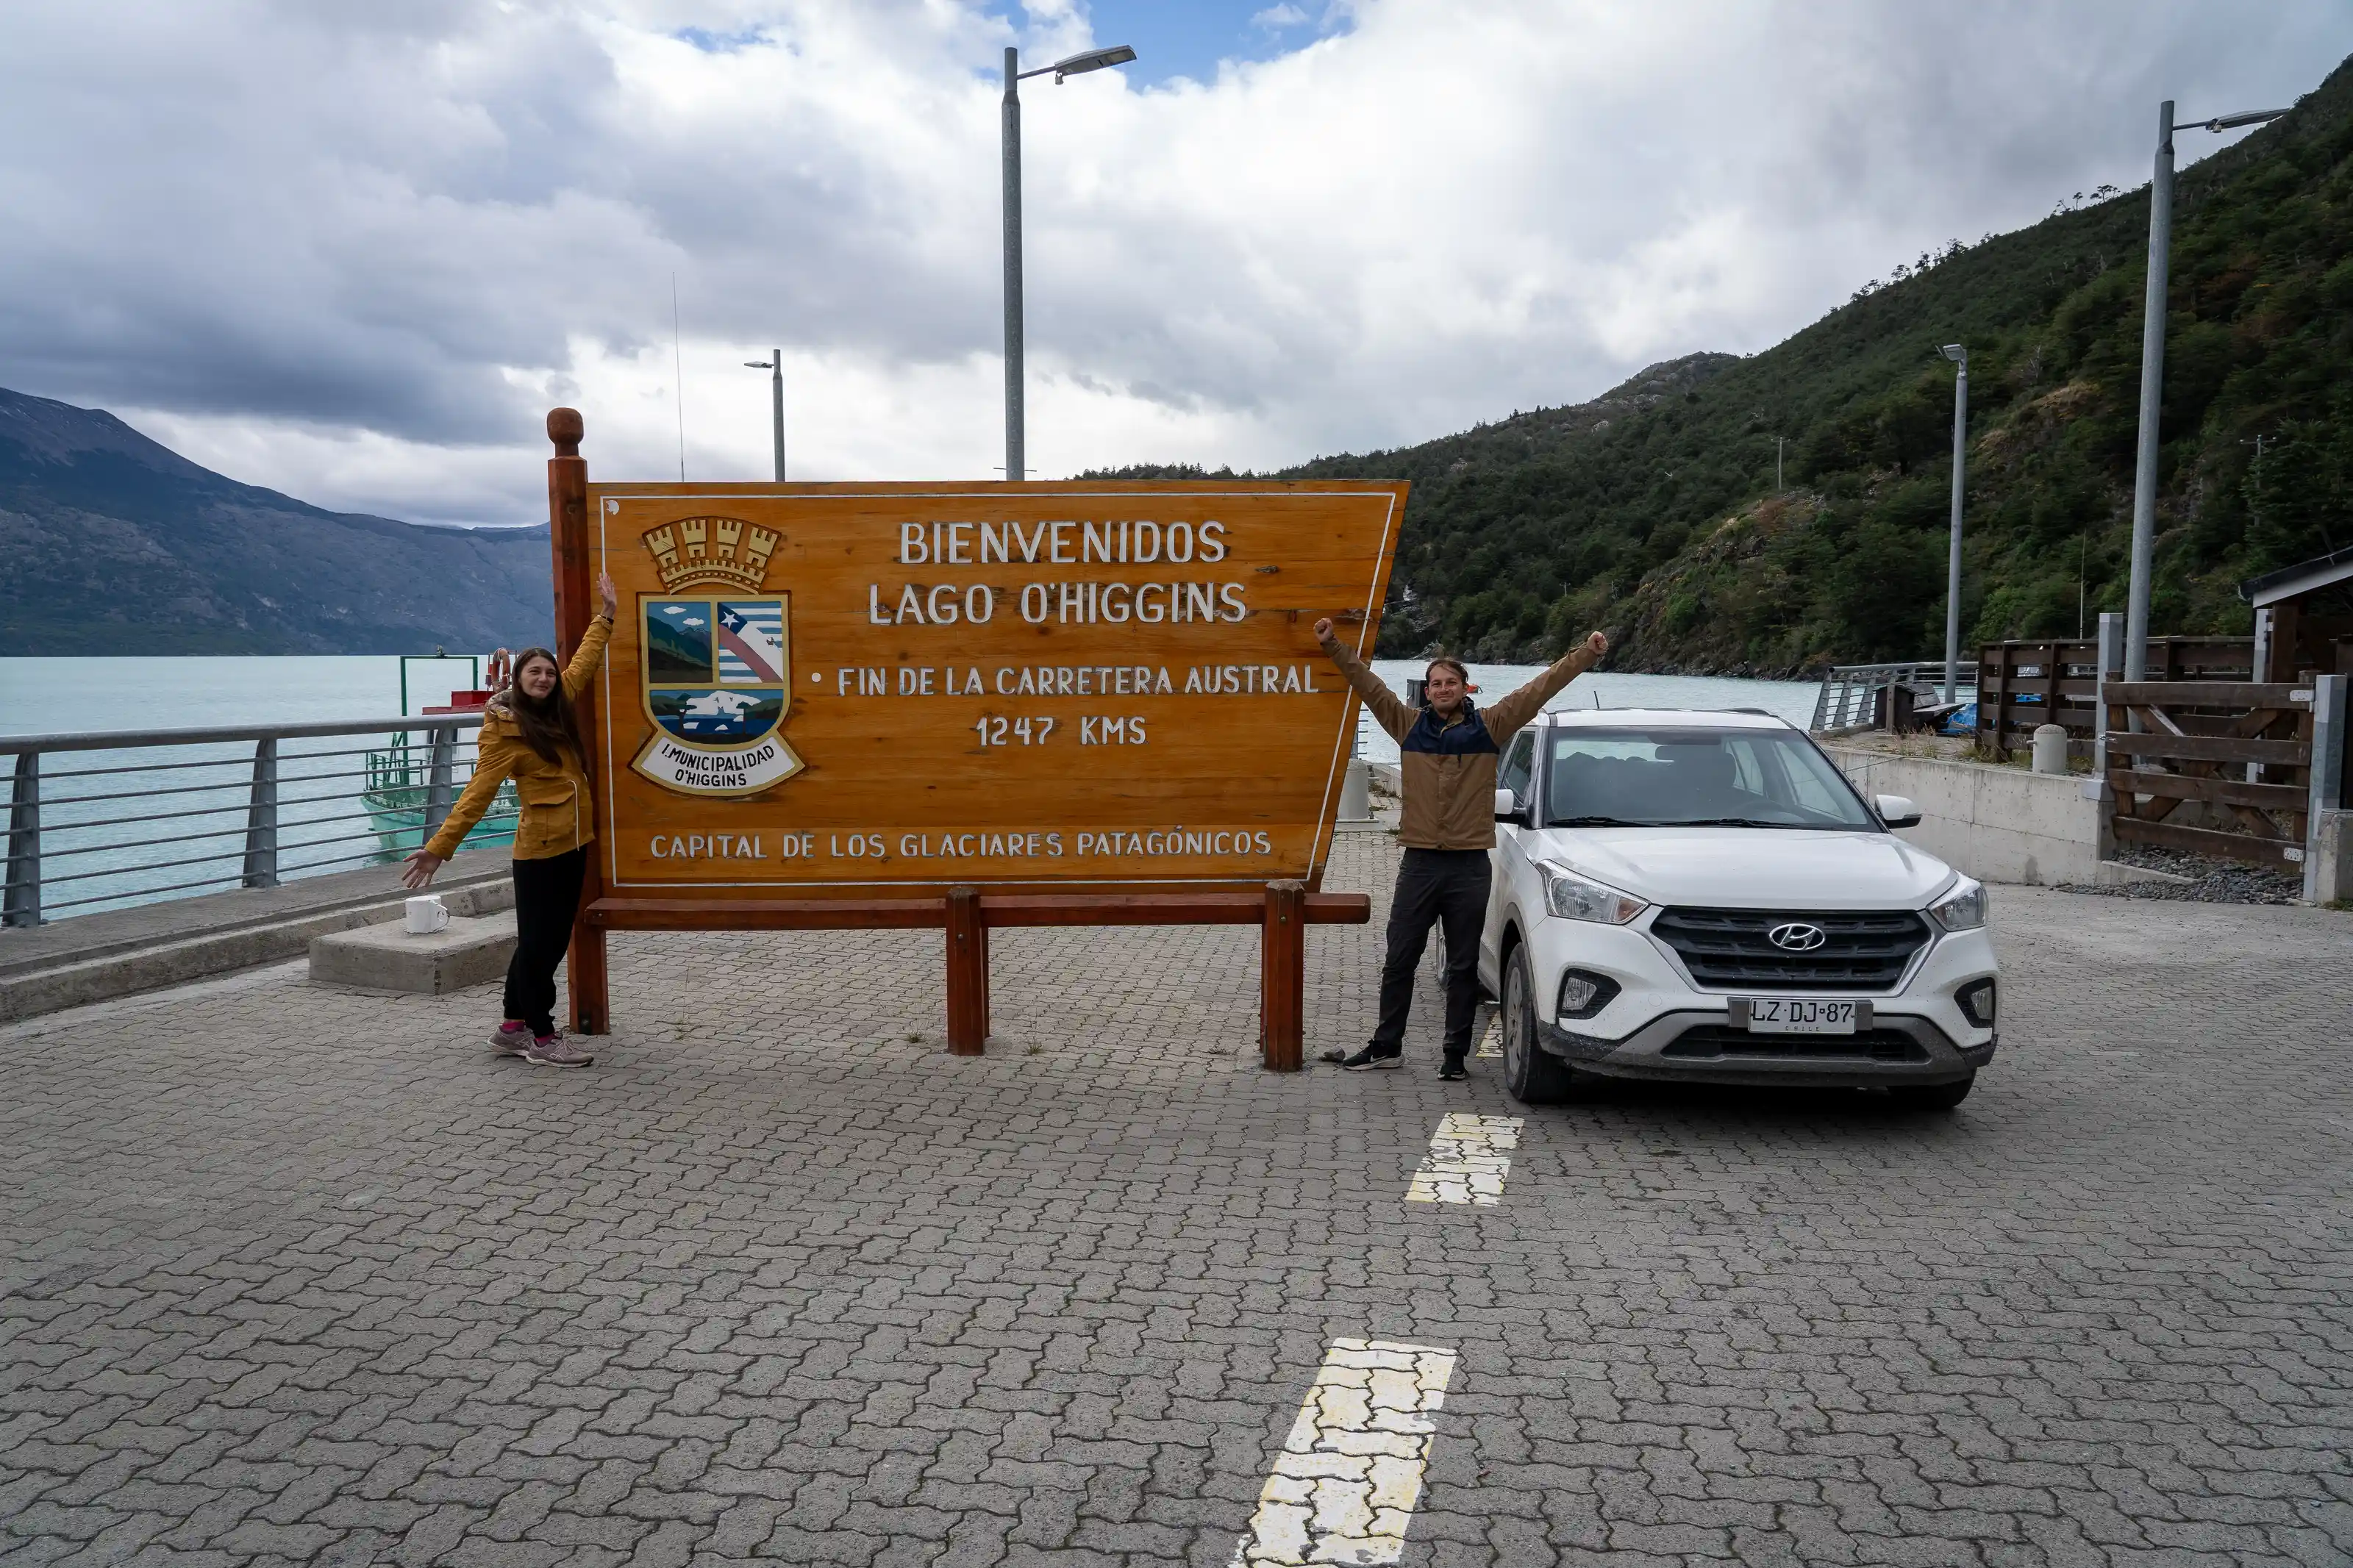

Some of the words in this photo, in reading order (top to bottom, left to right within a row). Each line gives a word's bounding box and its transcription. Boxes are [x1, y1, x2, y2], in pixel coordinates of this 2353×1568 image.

[899, 520, 1227, 564] BIENVENIDOS
[868, 582, 993, 625] LAGO
[1020, 581, 1247, 624] O'HIGGINS
[837, 667, 886, 697] FIN
[897, 667, 935, 696] DE
[946, 667, 985, 695] LA
[995, 665, 1174, 695] CARRETERA
[1184, 665, 1320, 694] AUSTRAL
[975, 716, 1055, 747] 1247
[1079, 715, 1147, 745] KMS
[674, 768, 747, 787] O'HIGGINS
[650, 834, 768, 859] CAPITAL
[782, 834, 815, 859] DE
[830, 833, 886, 858] LOS
[899, 832, 1064, 858] GLACIARES
[1076, 825, 1273, 856] PATAGÓNICOS
